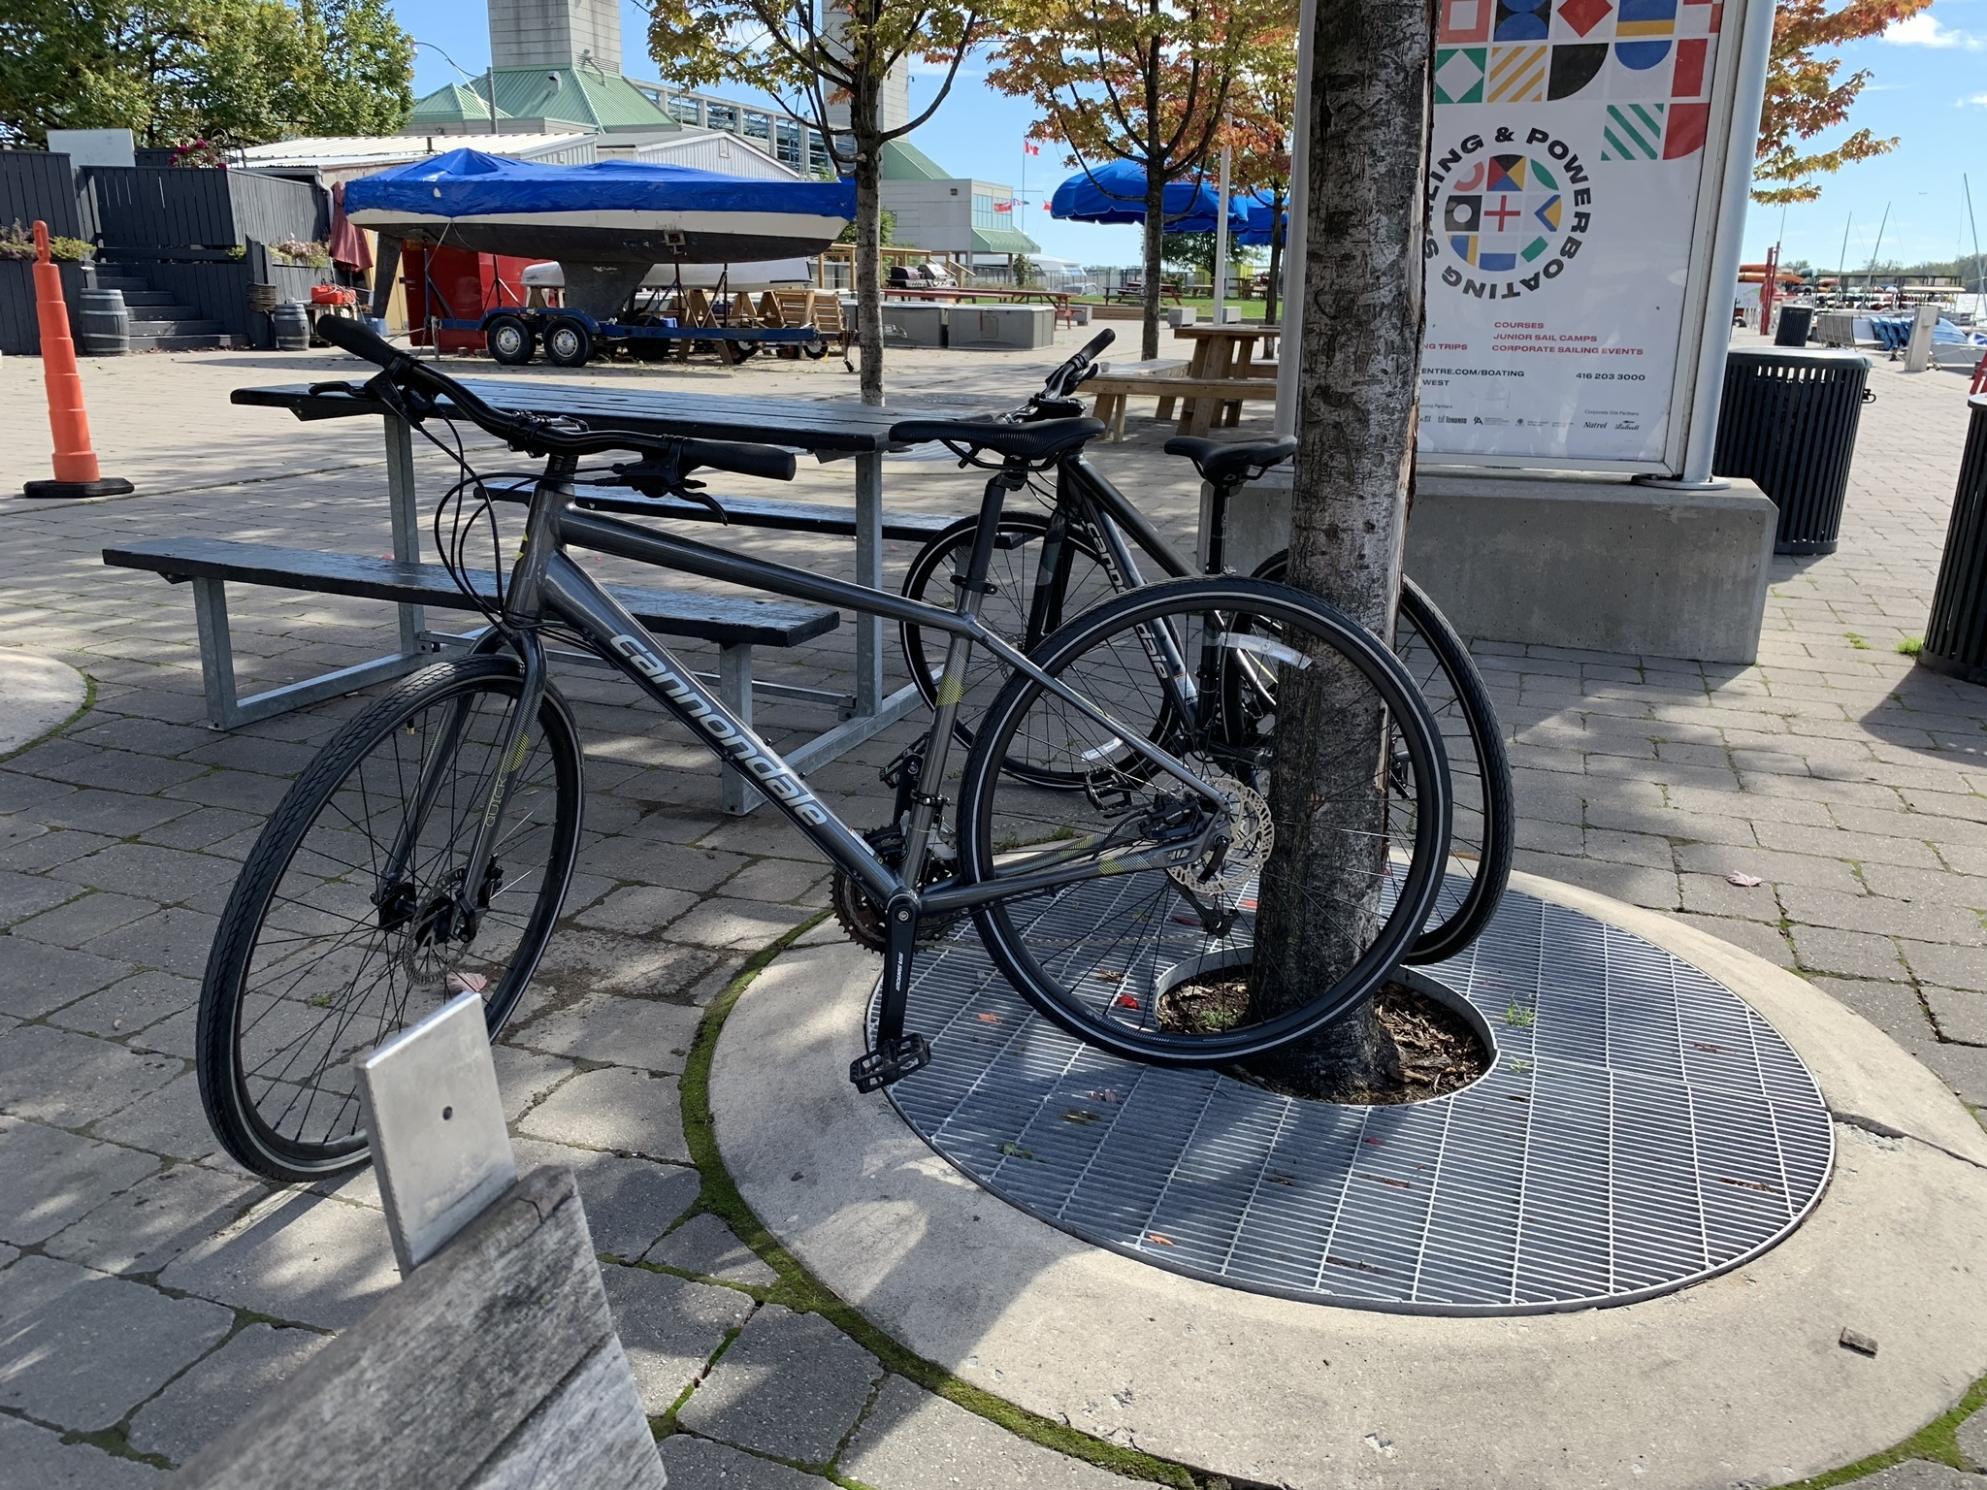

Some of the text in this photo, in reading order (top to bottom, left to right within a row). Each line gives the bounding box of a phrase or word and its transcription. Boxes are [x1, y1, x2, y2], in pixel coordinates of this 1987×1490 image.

[1424, 127, 1592, 300] SLING & POWERBOATING
[1494, 321, 1545, 329] COURSES
[1493, 333, 1533, 341] JUNIOR
[1534, 334, 1557, 342] SAIL
[1438, 343, 1468, 351] TRIPS
[1492, 344, 1644, 356] CORPORATE SAILING EVENTS
[1575, 372, 1593, 380] 416
[1617, 373, 1646, 381] 3000
[1087, 522, 1168, 679] canndale
[610, 633, 829, 827] cannondale
[485, 777, 508, 827] QUICK
